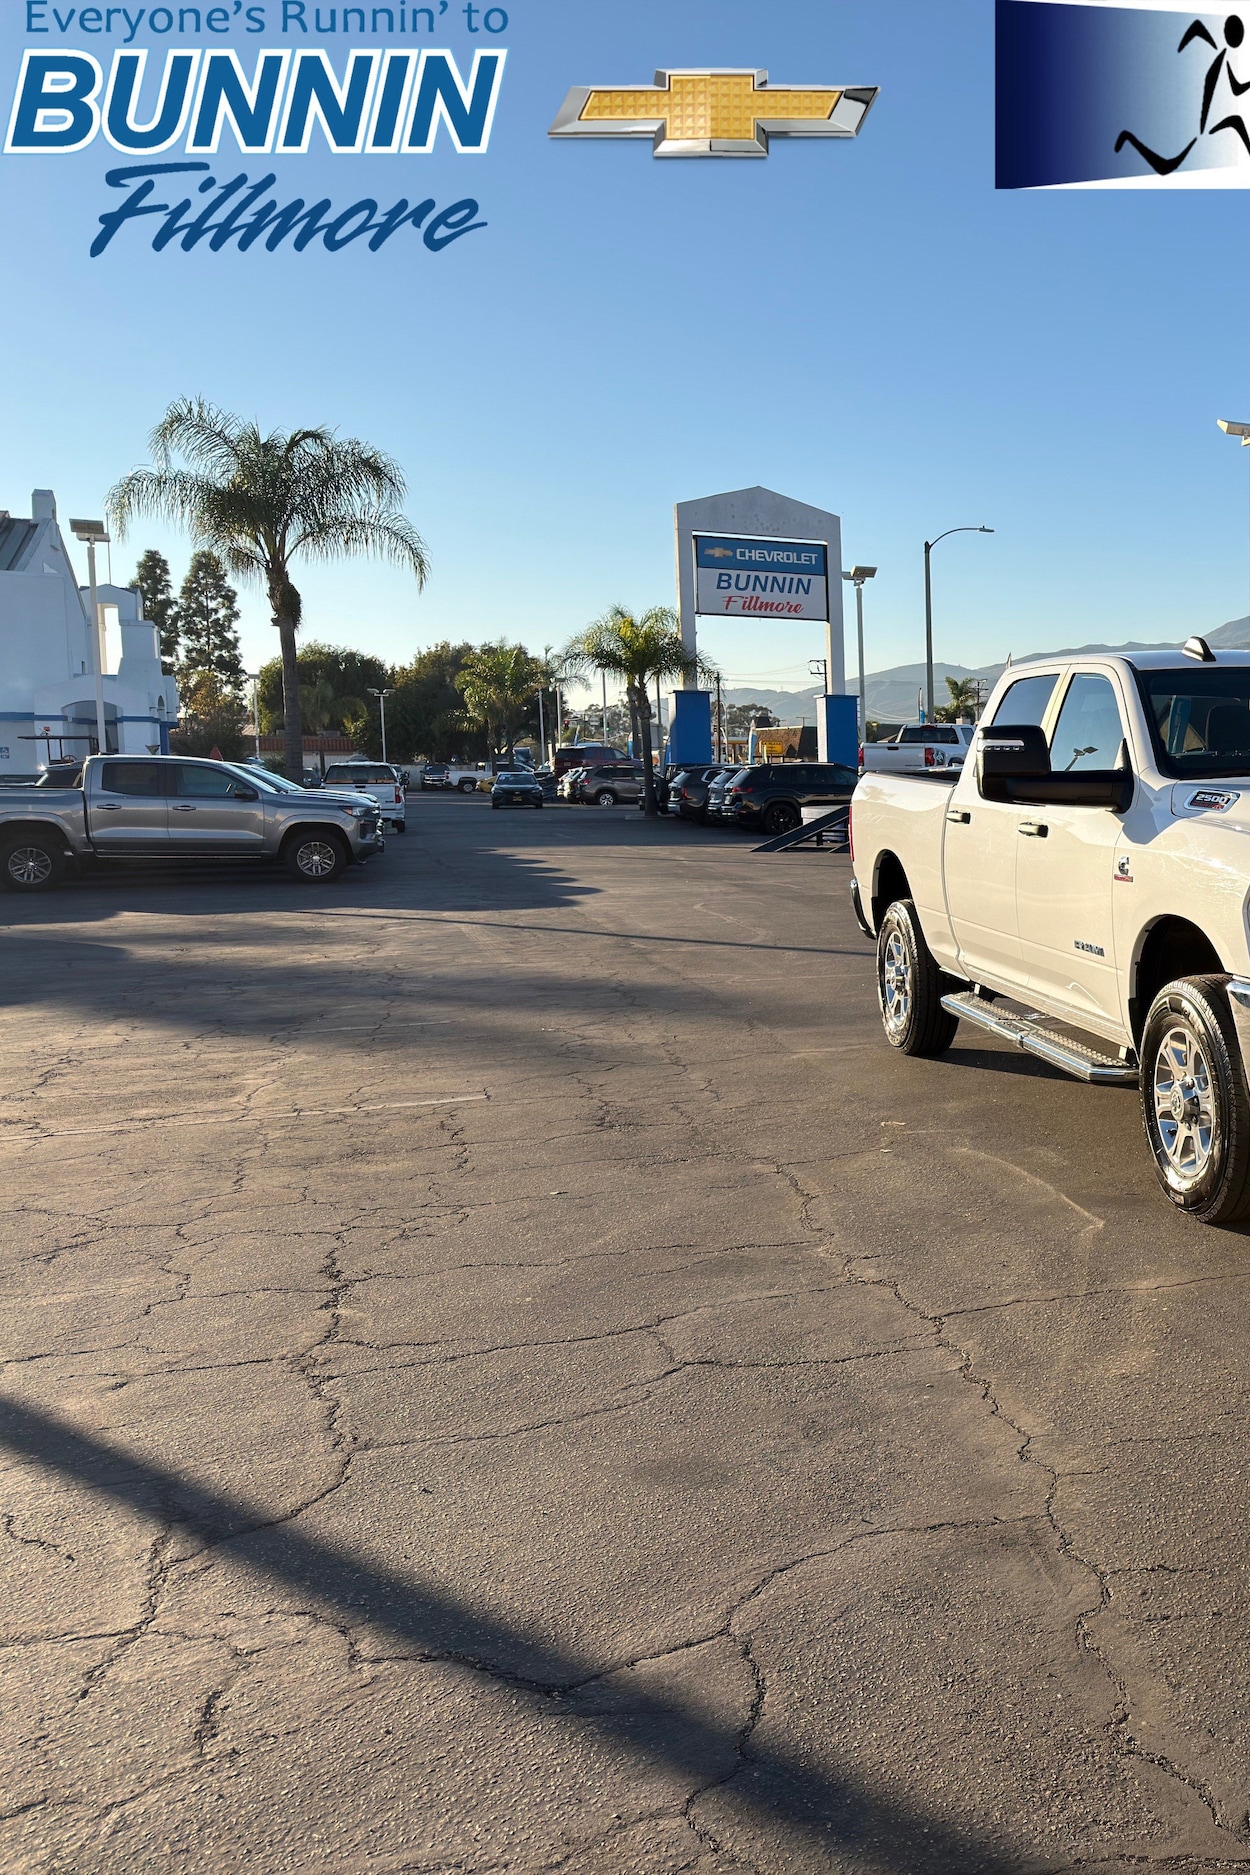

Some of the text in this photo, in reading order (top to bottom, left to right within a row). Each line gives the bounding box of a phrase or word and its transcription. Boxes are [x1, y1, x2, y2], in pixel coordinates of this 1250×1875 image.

[736, 548, 818, 565] CHEVROLET
[716, 572, 812, 595] BUNNIN
[721, 595, 804, 613] Fillmore
[1196, 793, 1229, 805] 2500
